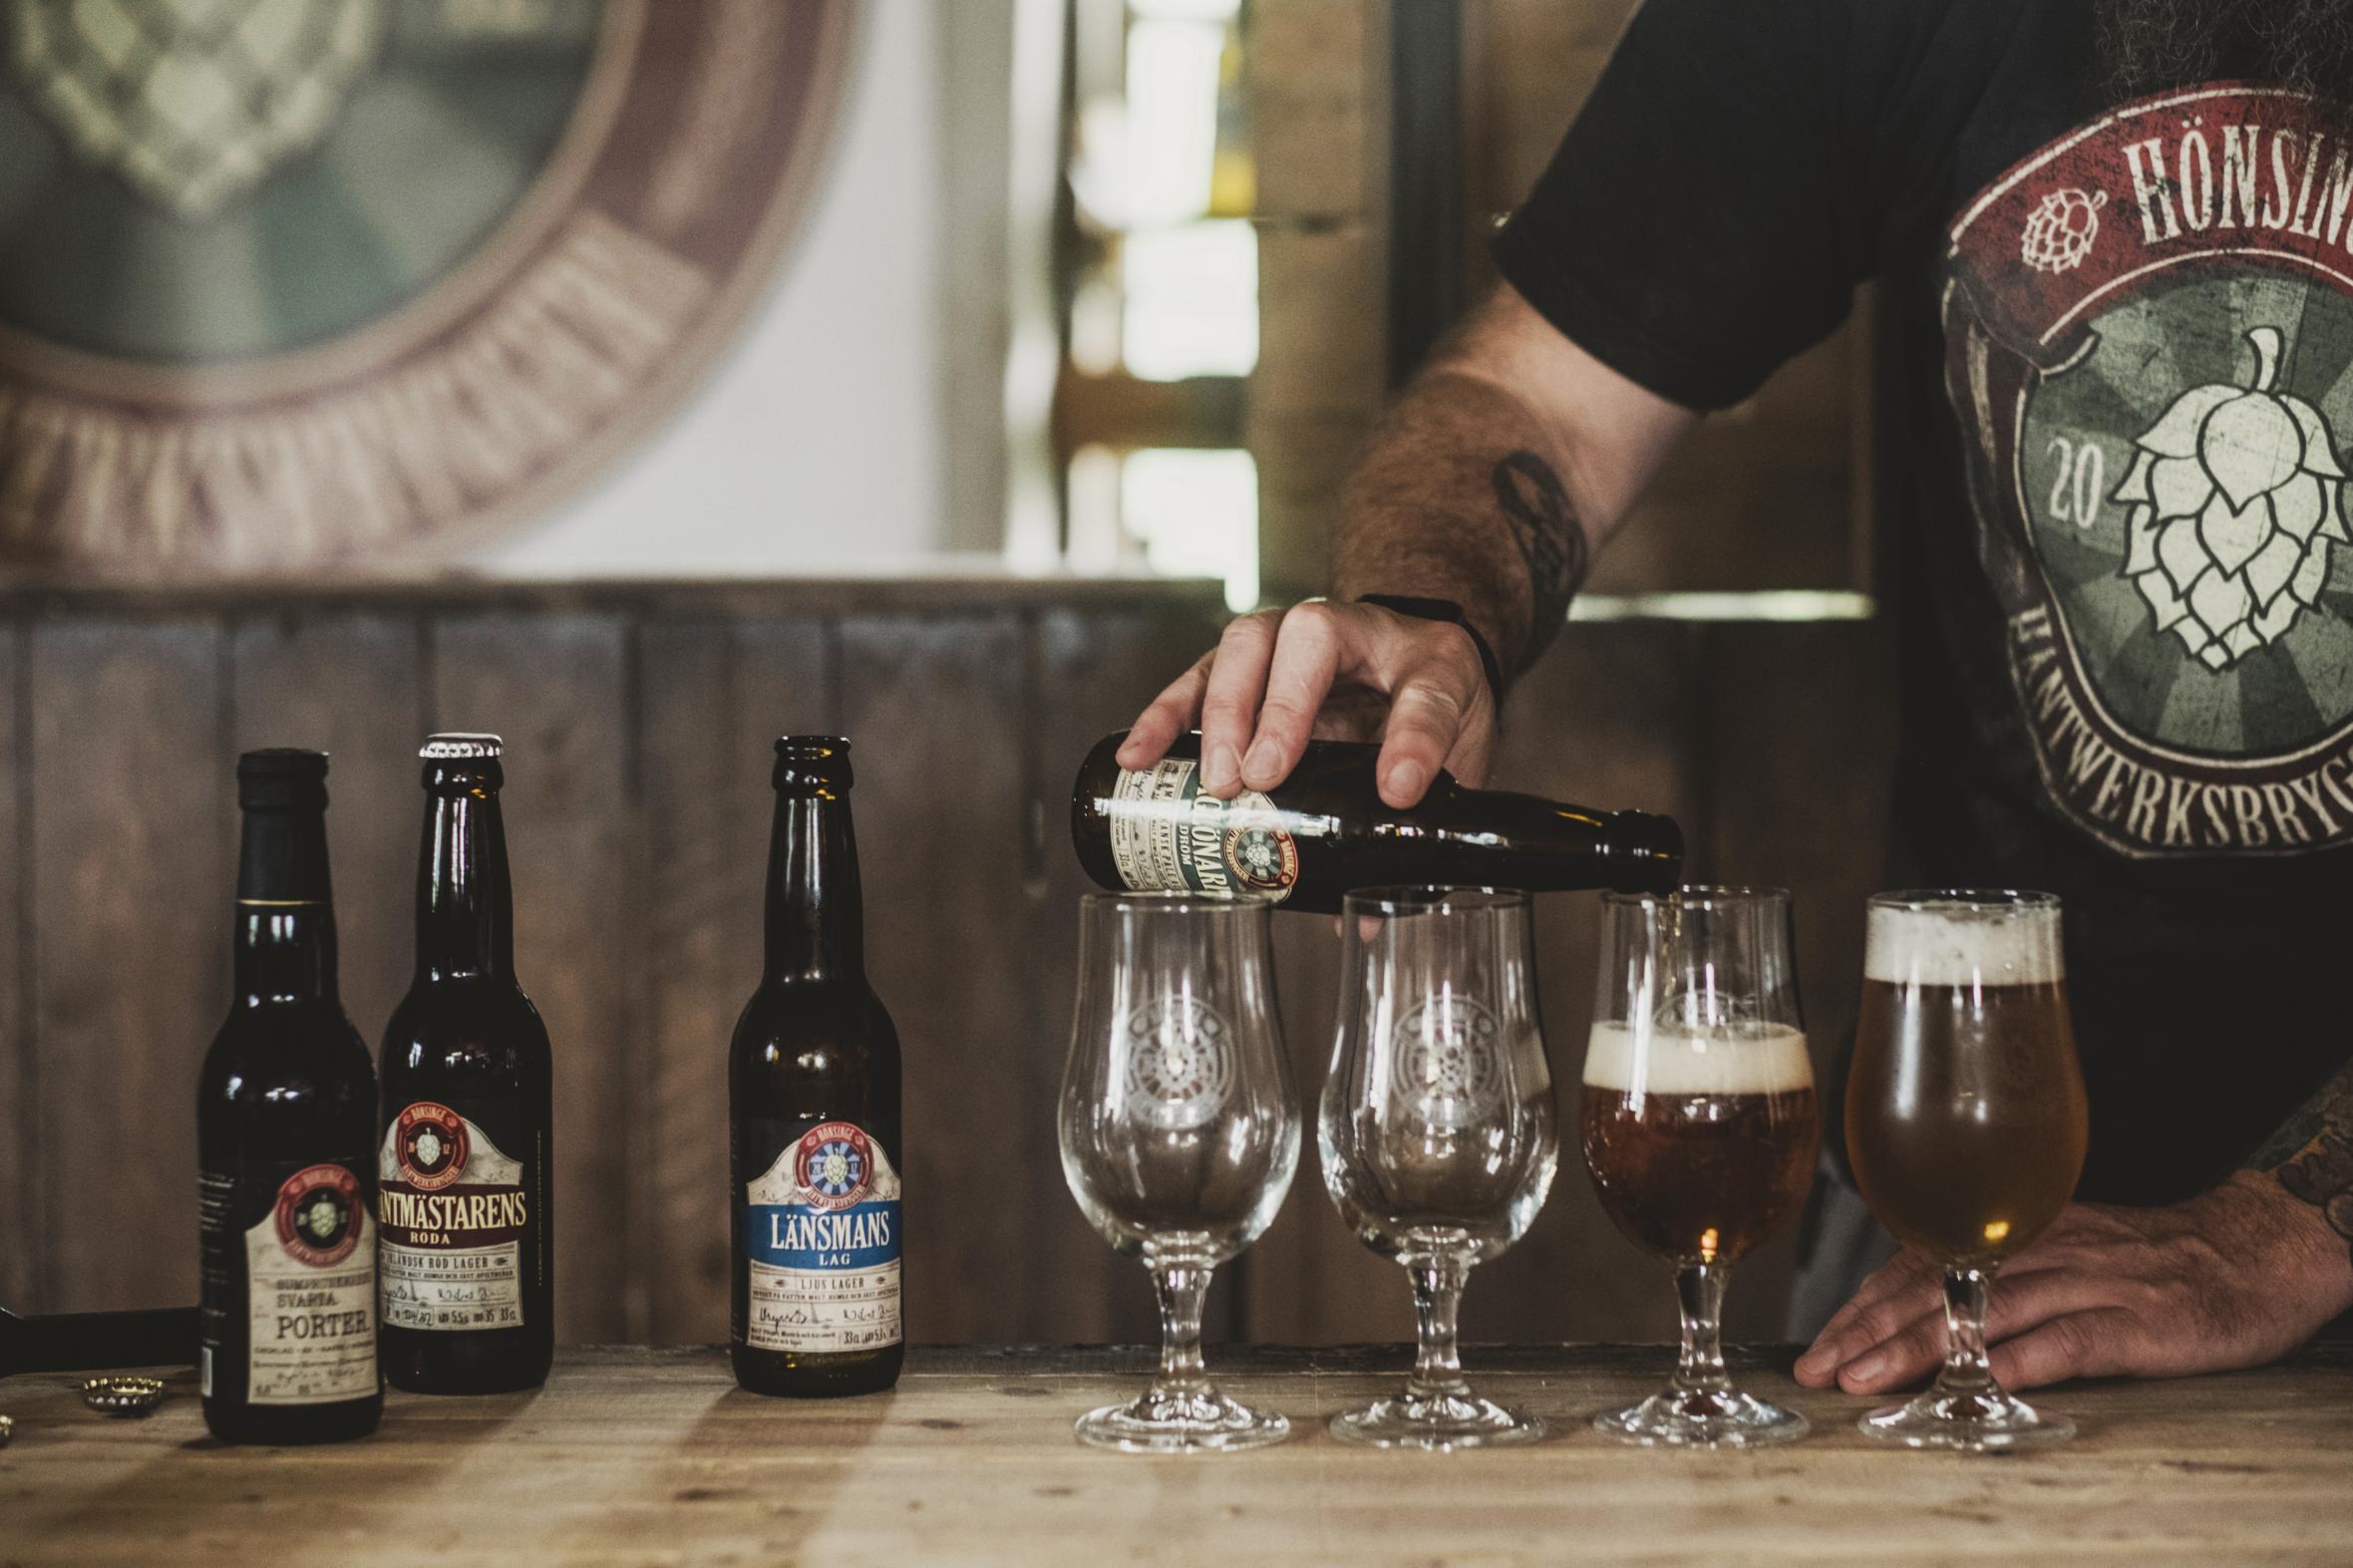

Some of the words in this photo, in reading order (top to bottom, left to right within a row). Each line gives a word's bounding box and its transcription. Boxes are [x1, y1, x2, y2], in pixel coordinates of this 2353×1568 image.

[2047, 436, 2104, 529] 20
[812, 1162, 822, 1174] 20
[380, 1187, 526, 1231] NTMÄSTARENS
[771, 1210, 890, 1252] LÄNSMANS
[454, 1257, 489, 1269] LAGER
[819, 1253, 850, 1266] LAG
[801, 1278, 827, 1290] LJUS
[832, 1277, 864, 1290] LAGER
[276, 1309, 371, 1340] PORTER
